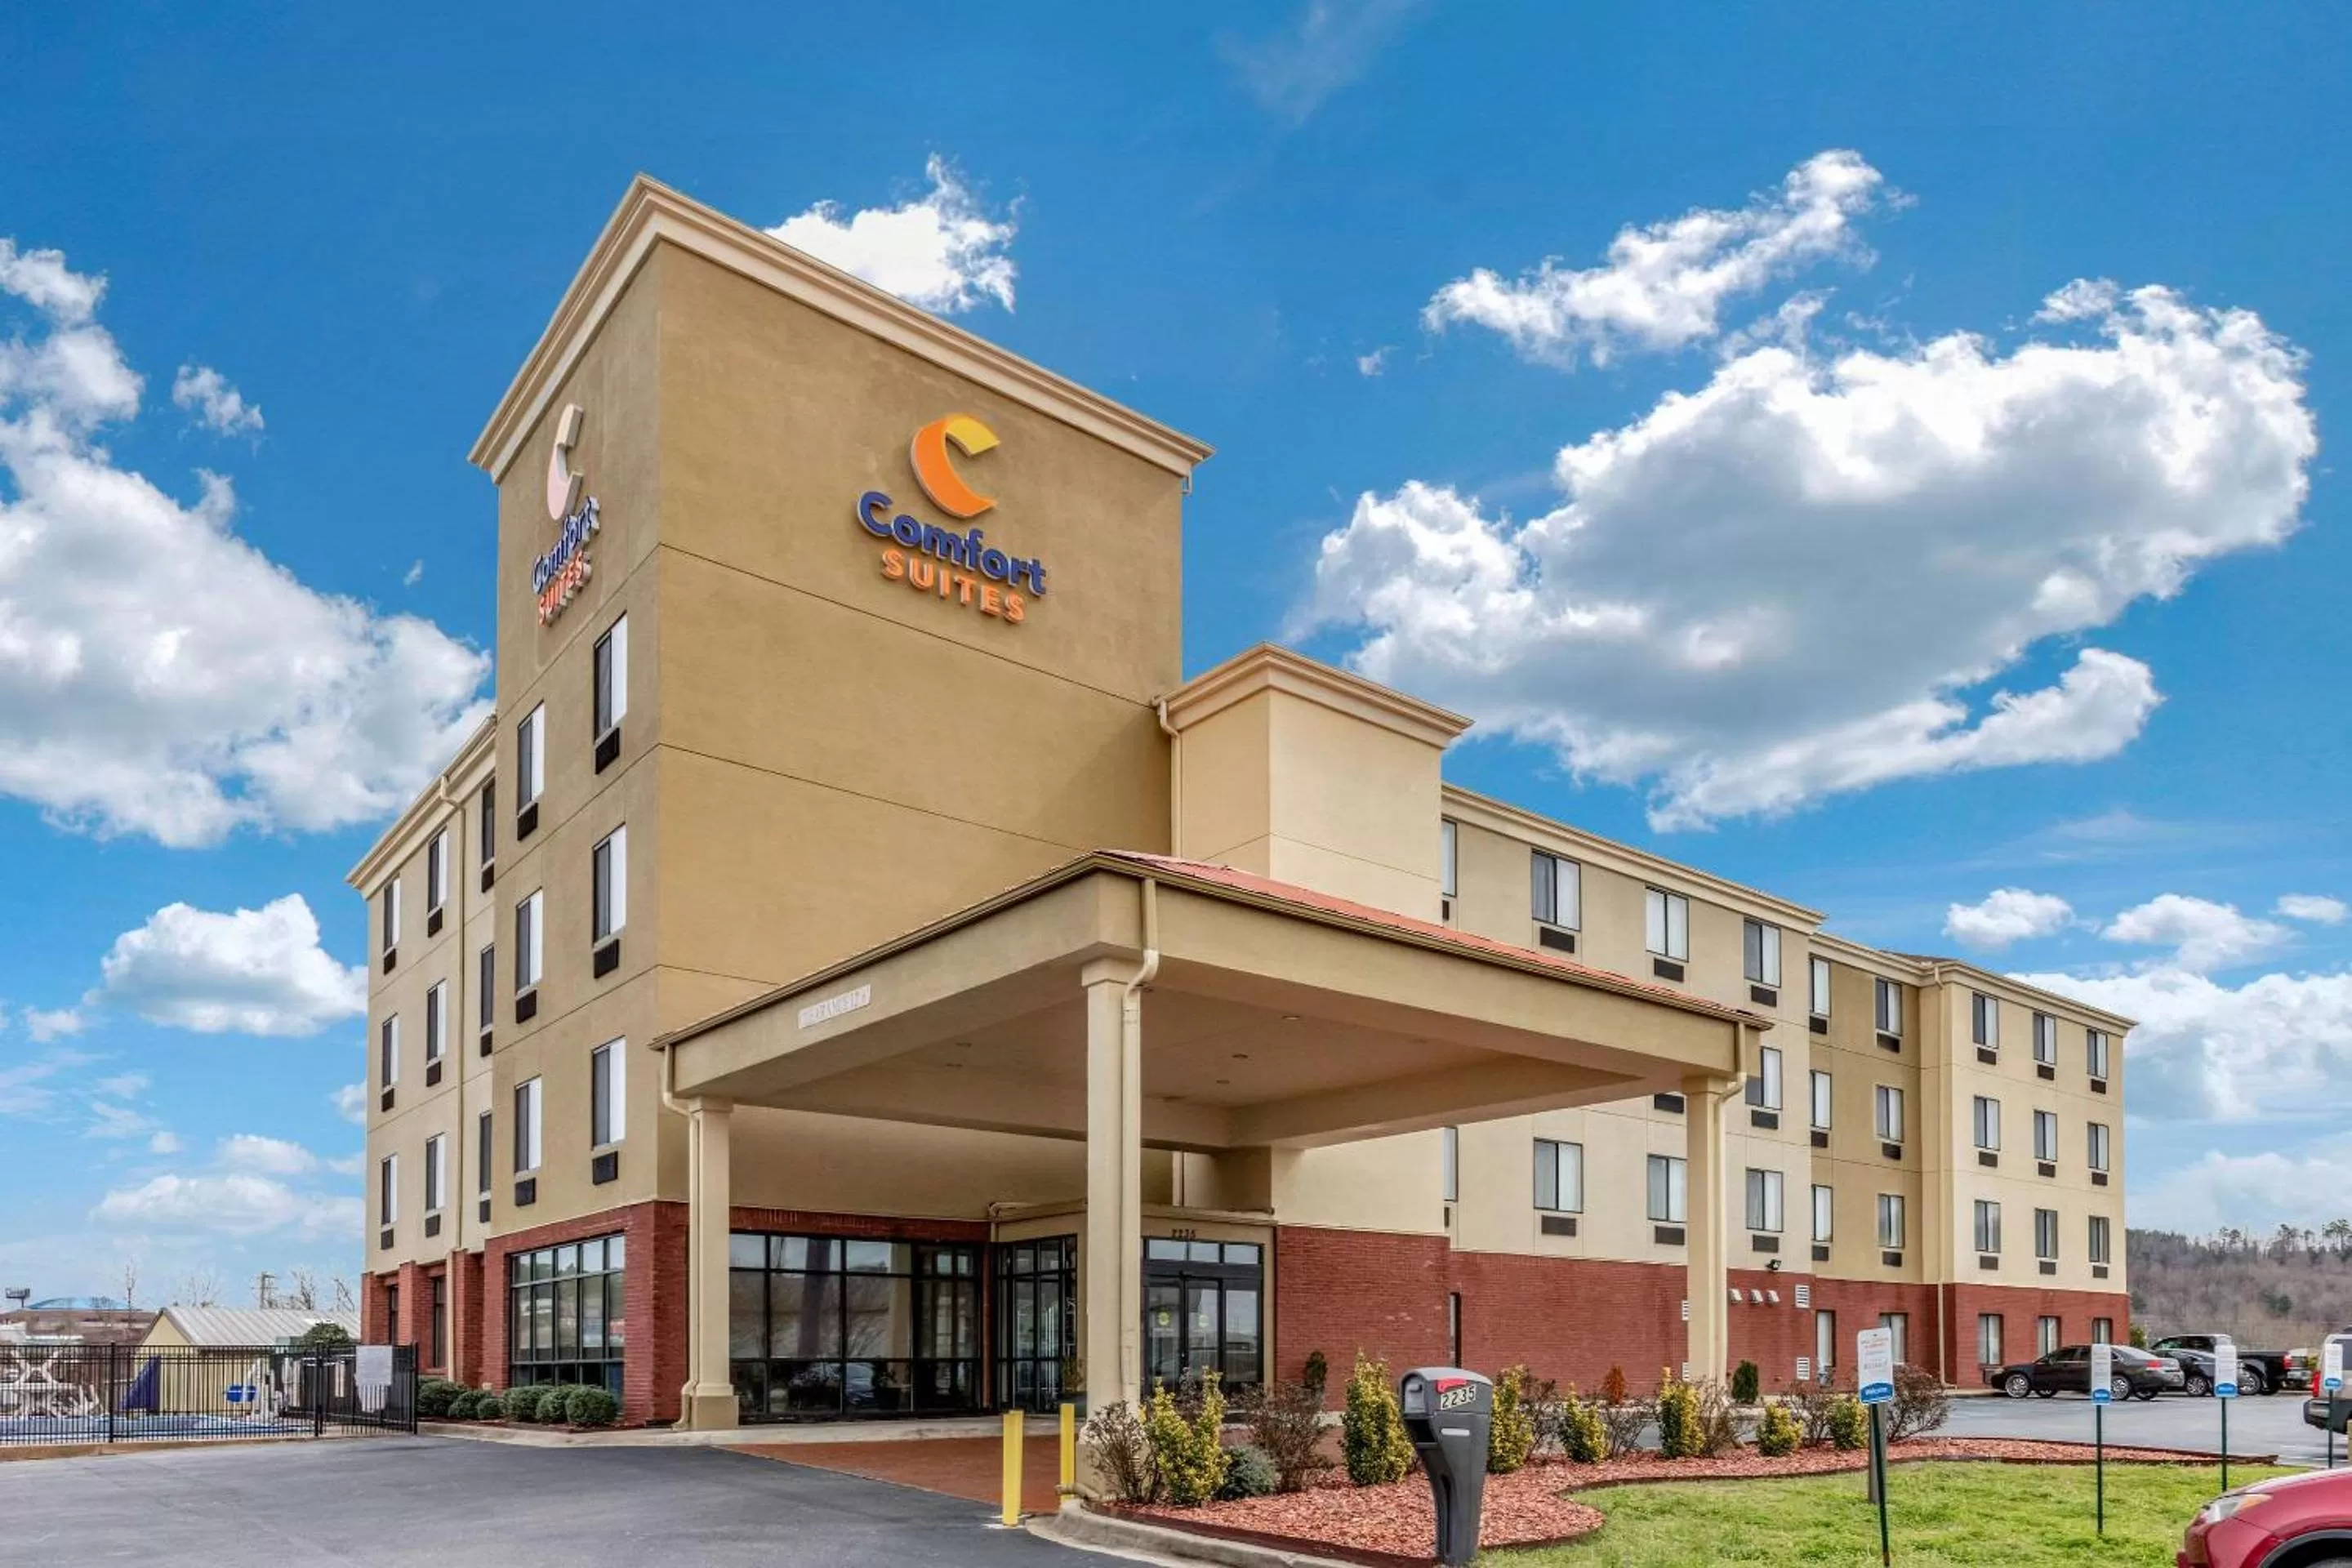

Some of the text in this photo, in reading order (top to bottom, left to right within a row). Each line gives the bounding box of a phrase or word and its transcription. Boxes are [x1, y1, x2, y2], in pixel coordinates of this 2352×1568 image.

[532, 496, 600, 595] Comfort
[858, 490, 1046, 596] Comfort
[881, 548, 1026, 624] SUITES
[1441, 1386, 1476, 1409] 2235
